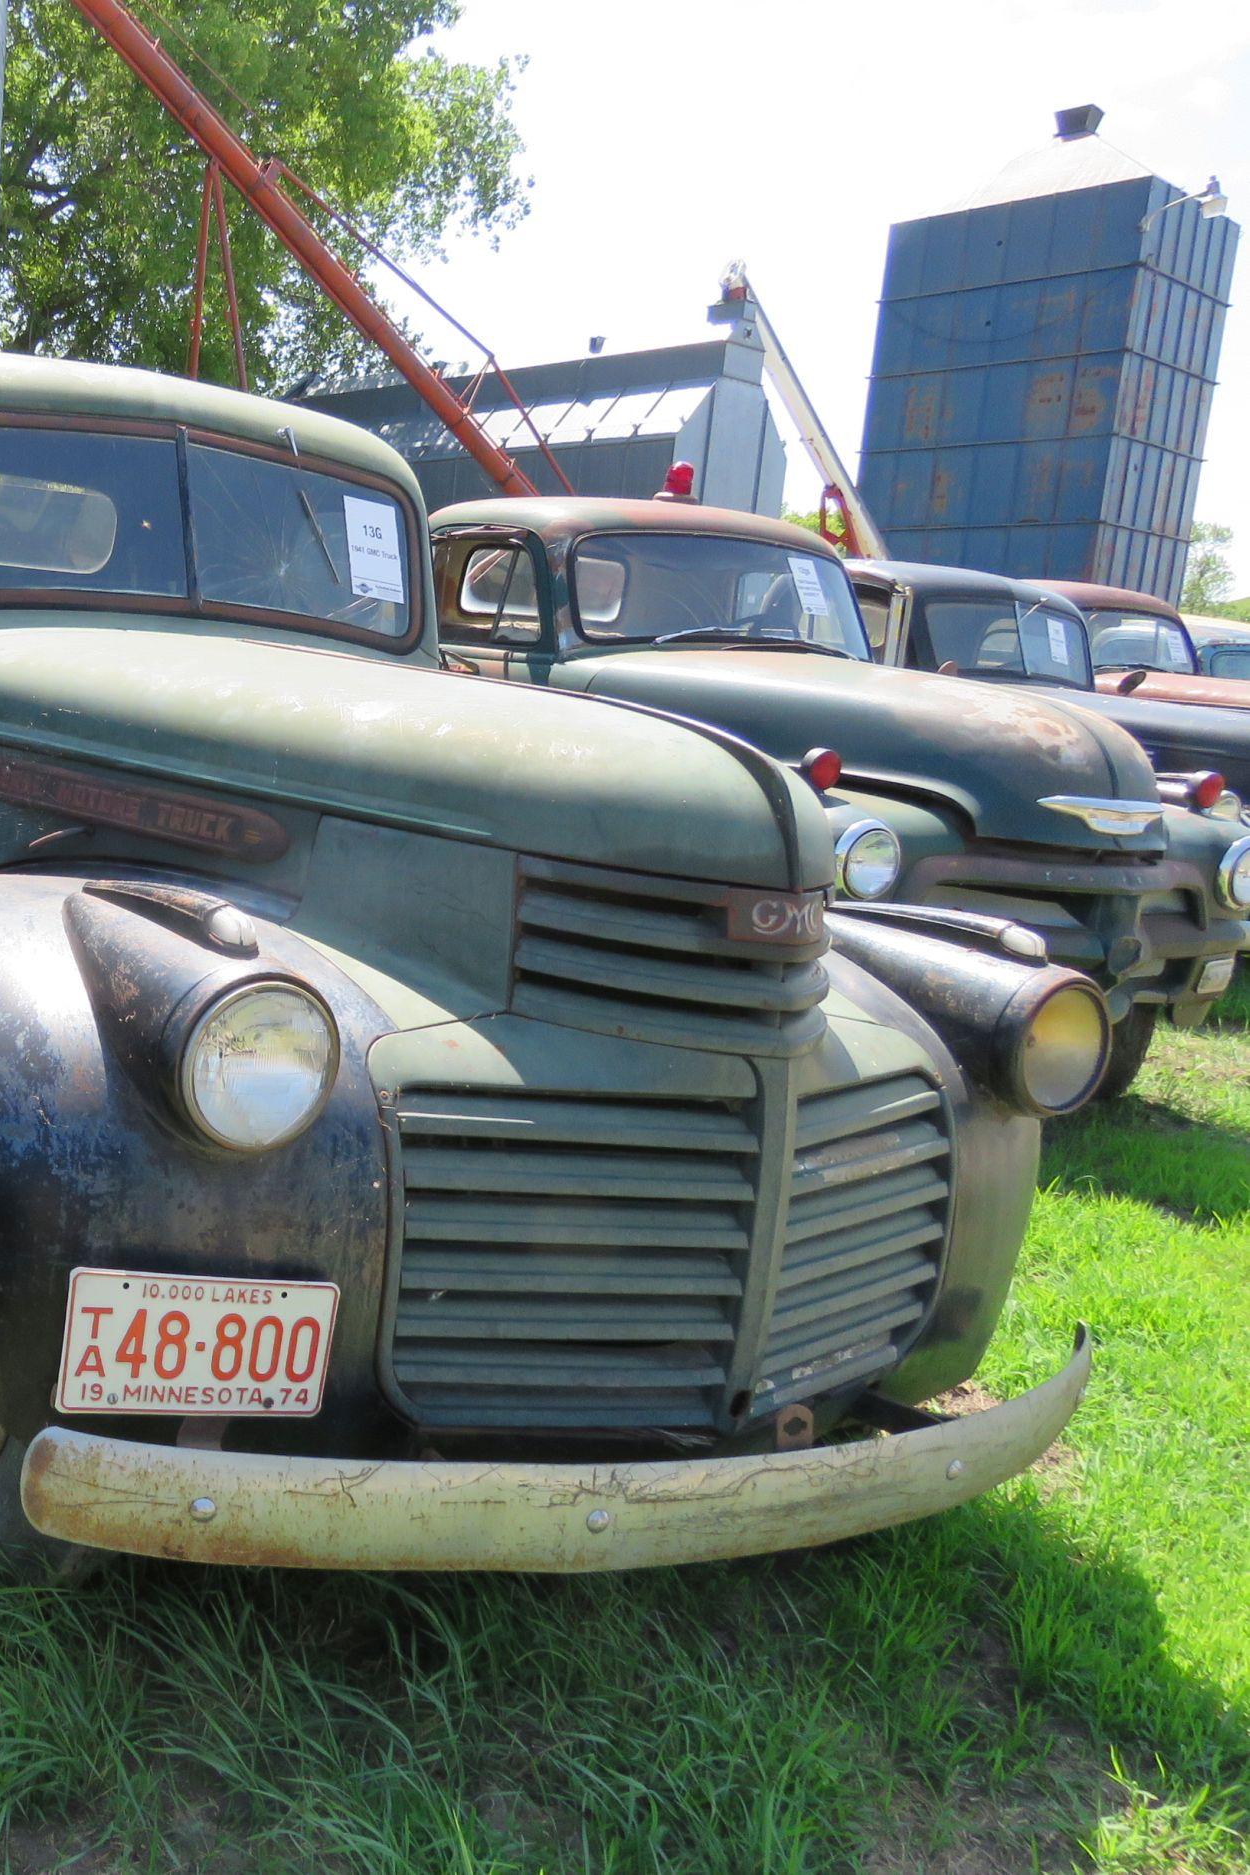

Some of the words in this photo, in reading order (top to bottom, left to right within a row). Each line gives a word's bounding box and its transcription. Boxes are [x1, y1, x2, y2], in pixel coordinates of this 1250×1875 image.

[363, 525, 382, 540] 13G
[382, 551, 398, 560] Truck
[158, 803, 232, 842] TRUCK
[211, 1286, 273, 1305] LAKES
[81, 1383, 104, 1401] 19
[123, 1384, 264, 1406] MINNESOTA
[280, 1387, 309, 1406] 74
